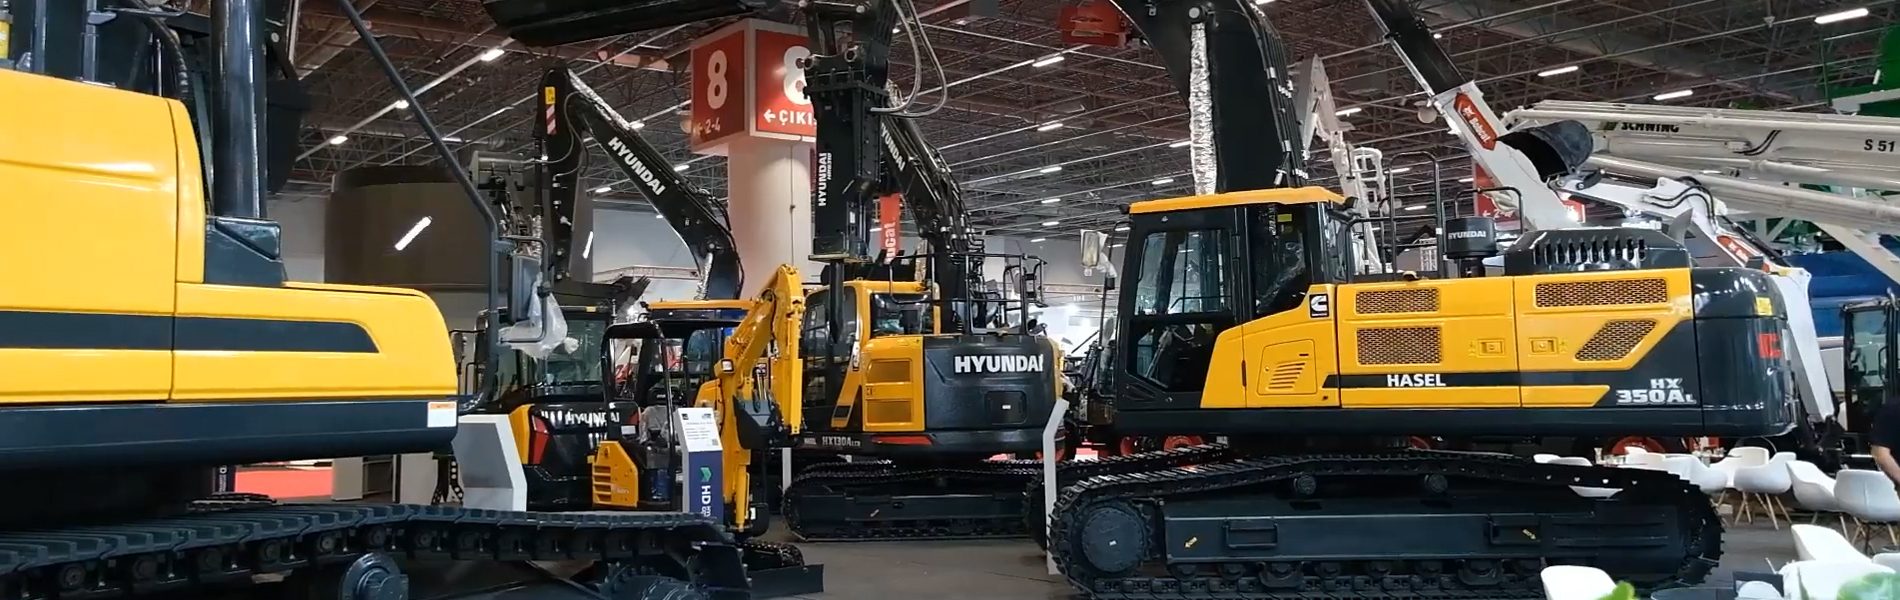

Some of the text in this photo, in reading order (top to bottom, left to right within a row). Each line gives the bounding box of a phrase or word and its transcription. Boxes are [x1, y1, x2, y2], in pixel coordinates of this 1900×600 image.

[707, 49, 728, 109] 8
[783, 45, 812, 105] 8
[779, 109, 817, 126] ÇIKI
[1863, 138, 1895, 153] S 51
[607, 136, 667, 196] HYUNDAI
[818, 152, 827, 207] HYUNDAI
[1447, 230, 1487, 240] HYUNDAI
[954, 354, 1044, 374] HYUNDAI
[1386, 373, 1447, 387] HASEL
[1650, 377, 1683, 389] HX
[701, 485, 711, 505] HD
